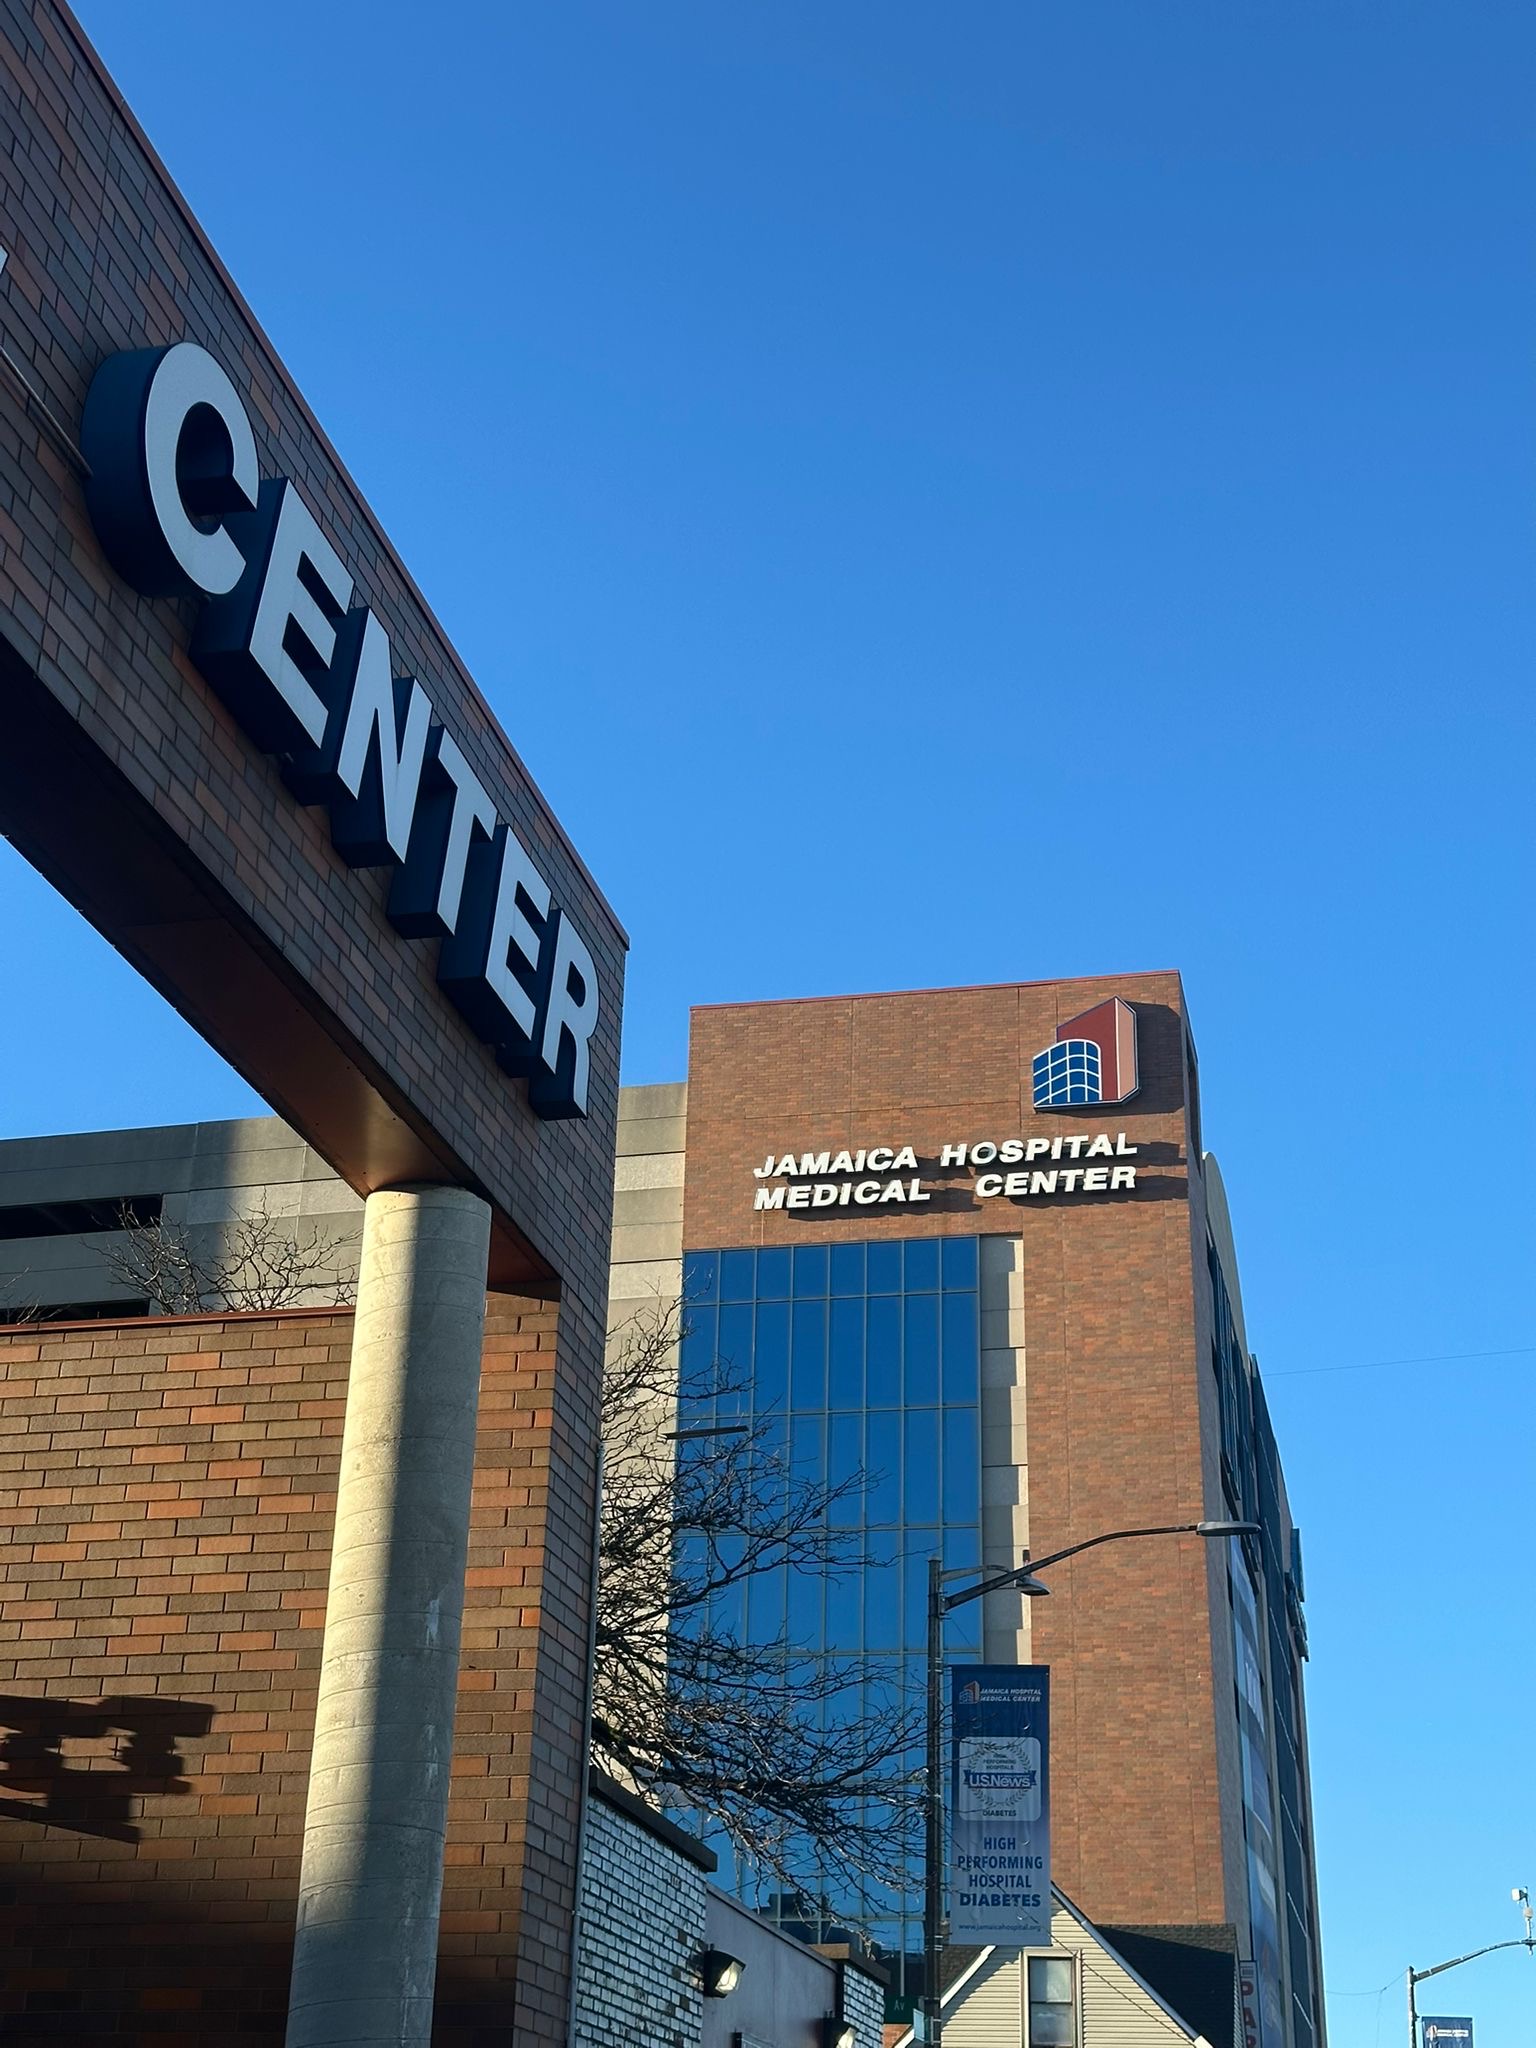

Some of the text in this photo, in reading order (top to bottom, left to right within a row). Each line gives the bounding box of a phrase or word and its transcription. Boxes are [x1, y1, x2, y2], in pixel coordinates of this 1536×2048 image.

[141, 341, 601, 1119] CENTER
[753, 1132, 1138, 1179] JAMAICA HOSPITAL
[753, 1166, 1138, 1212] MEDICAL CENTER
[980, 1687, 1042, 1696] JAMAICA HOSPITAL
[982, 1809, 1017, 1817] DIABETES
[983, 1837, 1016, 1850] HIGH
[957, 1855, 1043, 1869] PERFORMING
[968, 1874, 1032, 1888] HOSPITAL
[959, 1893, 1041, 1907] DIABETES
